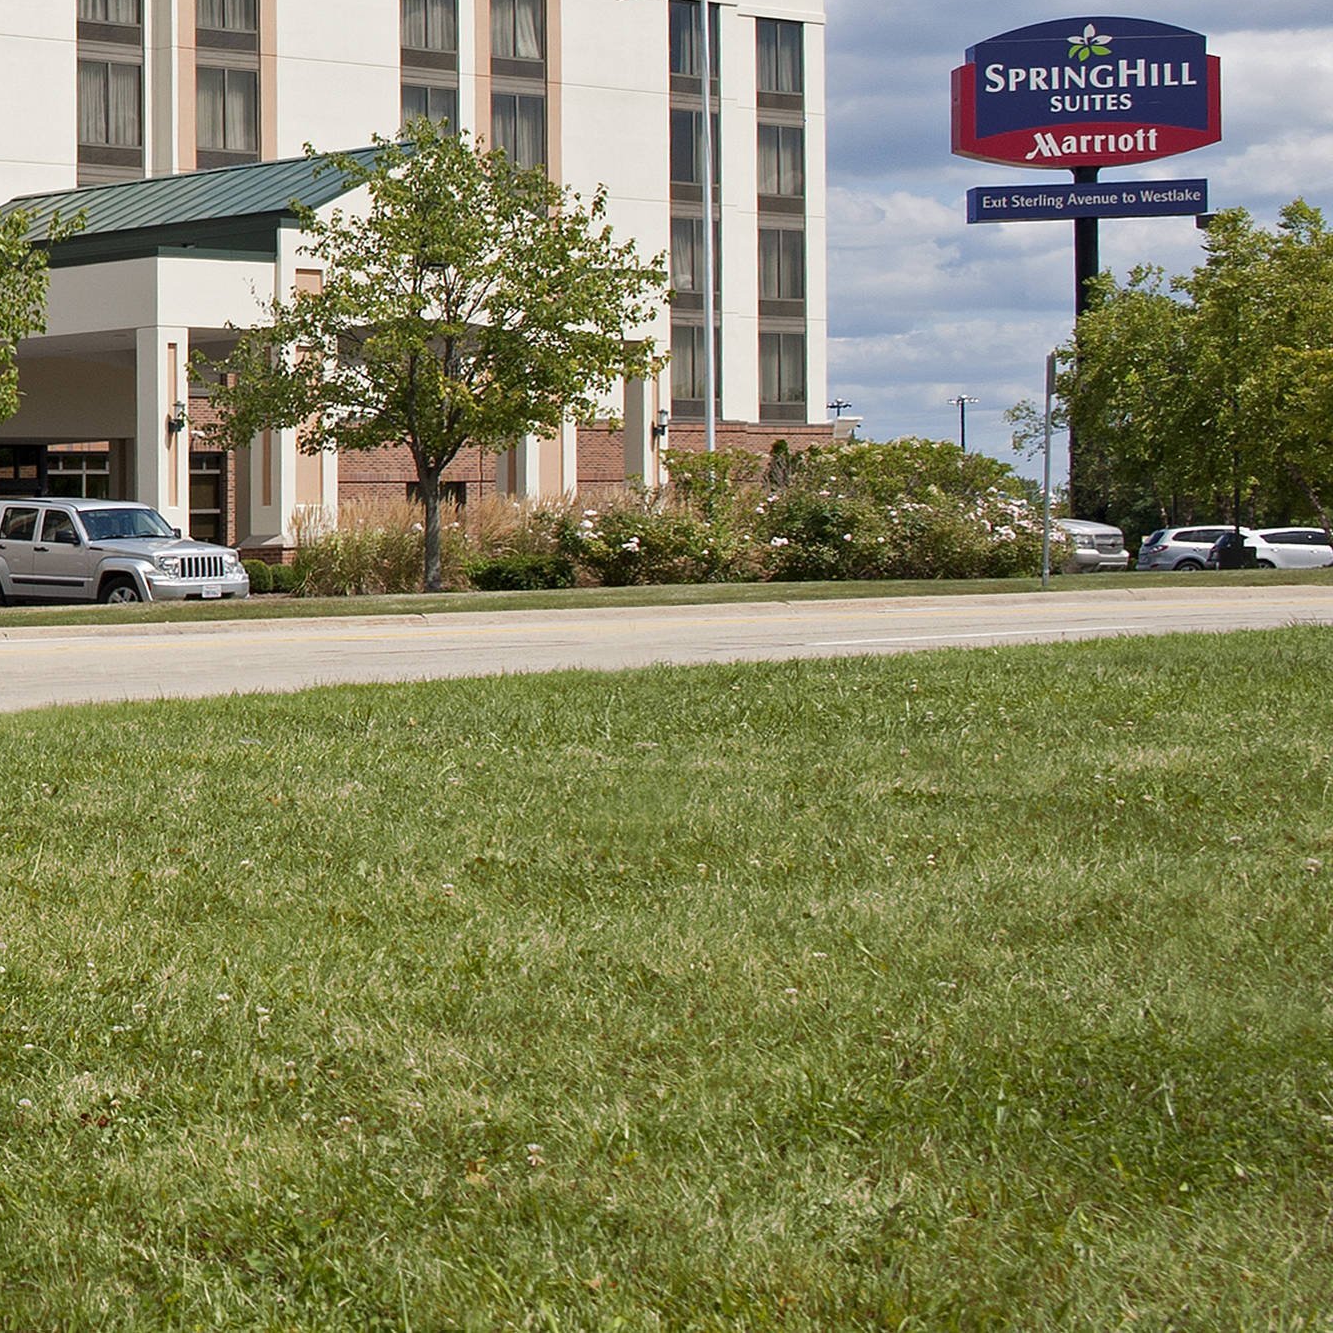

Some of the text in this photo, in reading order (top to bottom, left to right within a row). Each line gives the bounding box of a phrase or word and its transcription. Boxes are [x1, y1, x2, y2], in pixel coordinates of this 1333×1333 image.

[1049, 93, 1133, 112] SUITES
[1025, 128, 1158, 160] Marriott
[982, 188, 1201, 210] Exit Sterling Avenue to Westlake
